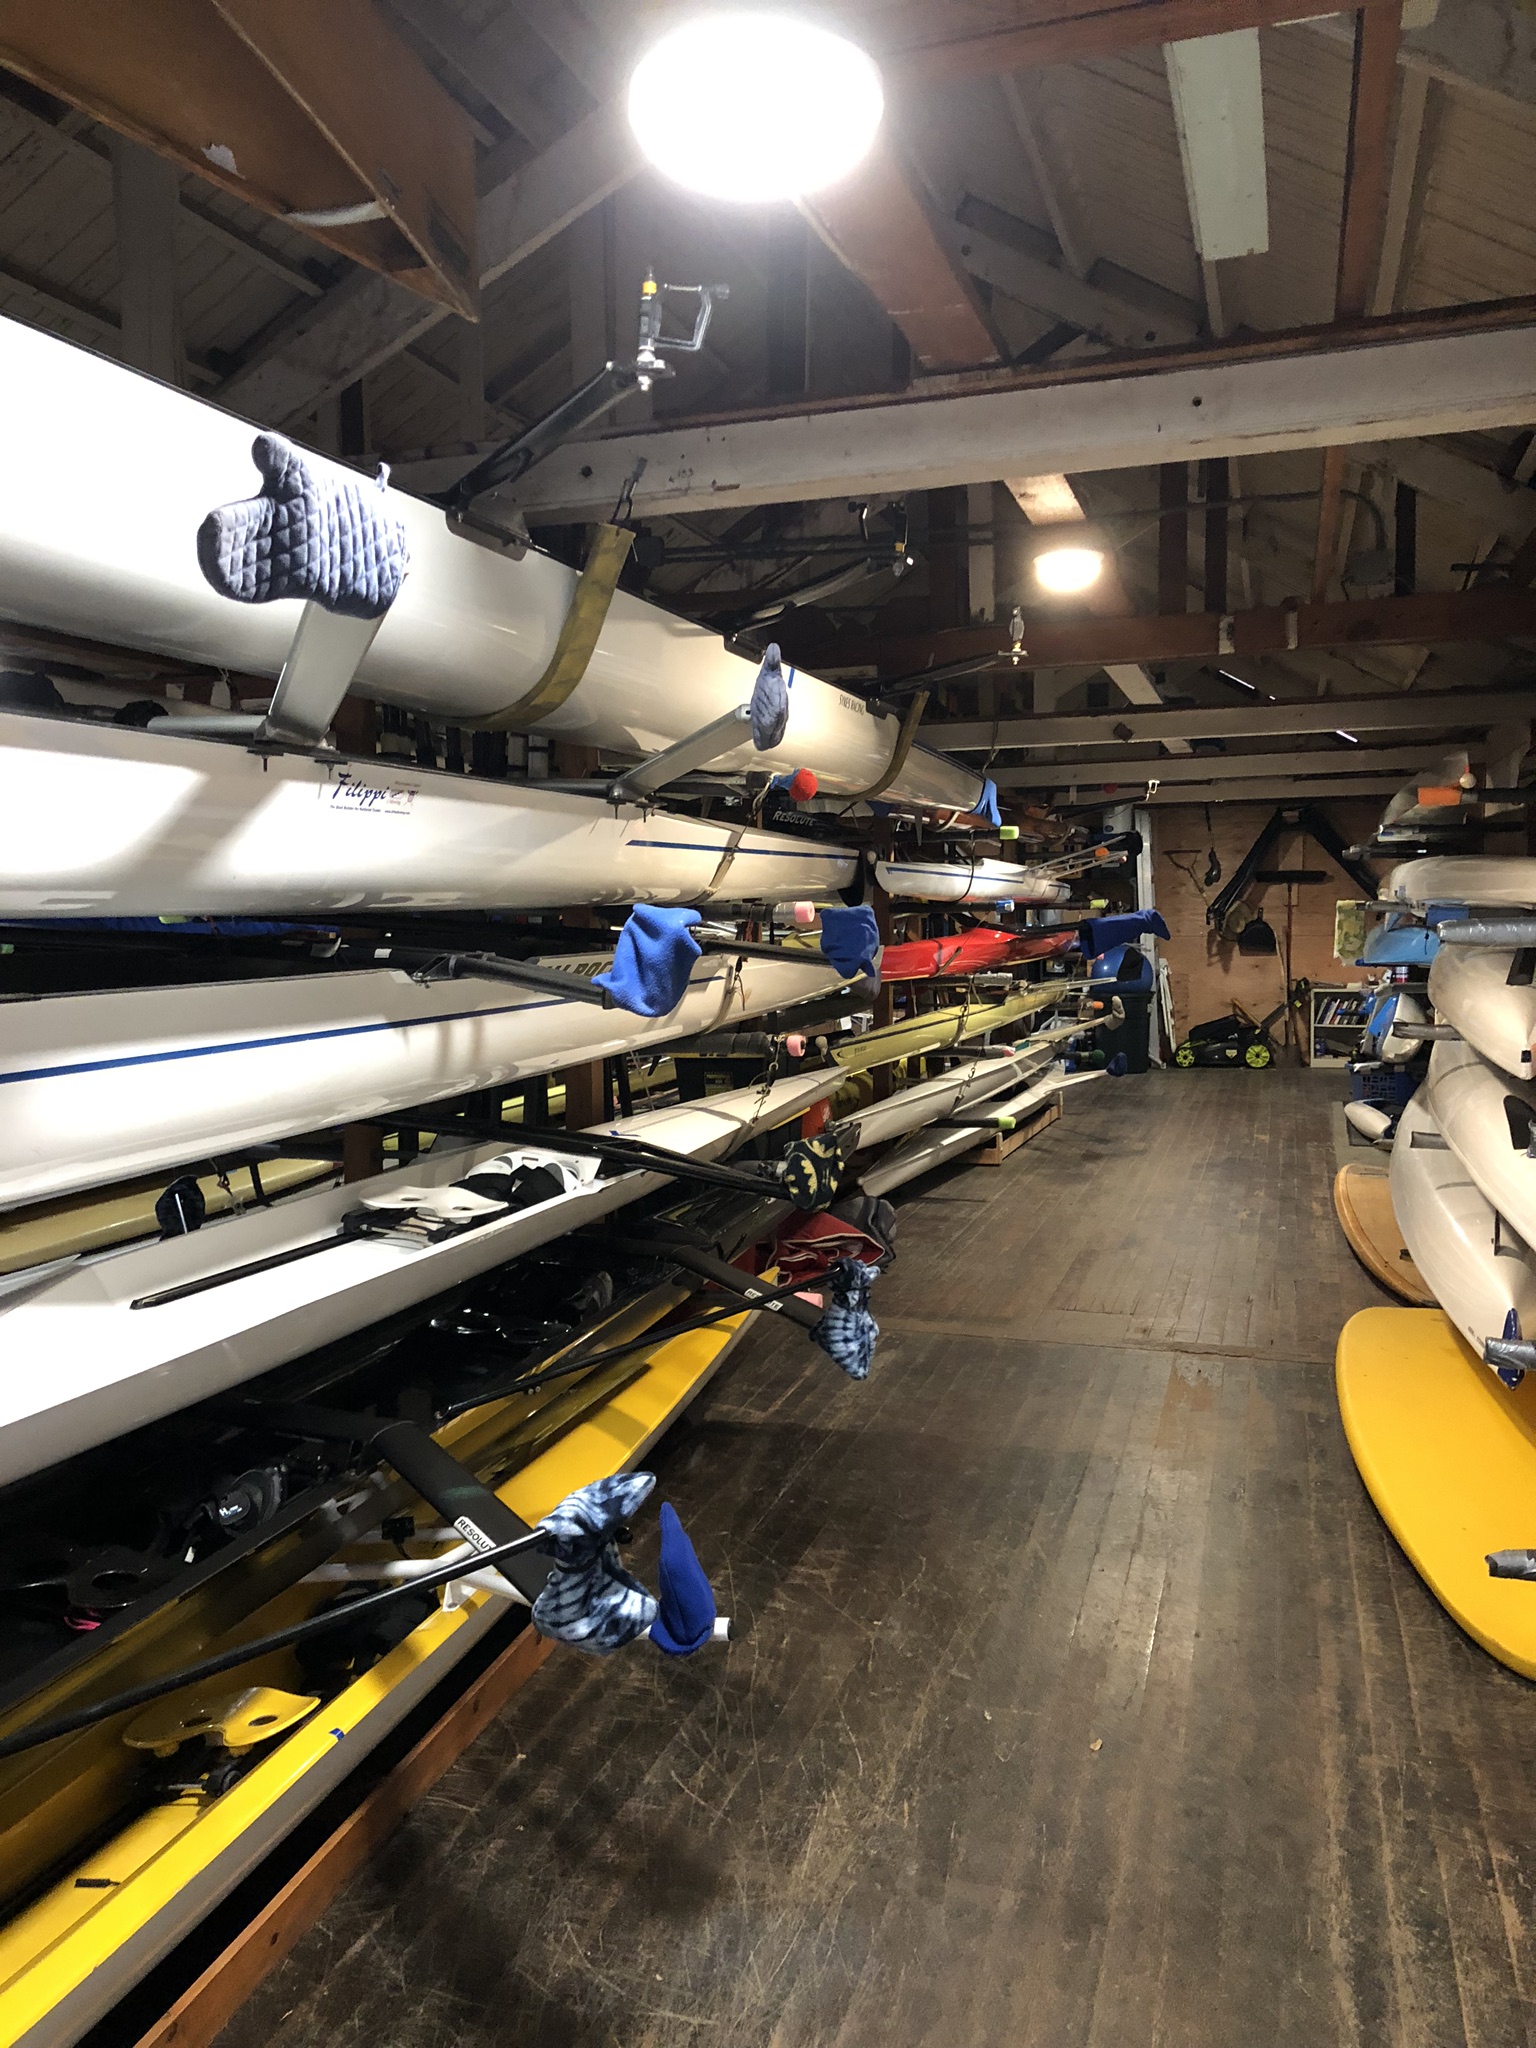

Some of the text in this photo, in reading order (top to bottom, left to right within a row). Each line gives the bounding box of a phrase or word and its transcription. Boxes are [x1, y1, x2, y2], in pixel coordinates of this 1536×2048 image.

[332, 772, 390, 807] Filippi
[772, 810, 816, 827] RESOLUTE
[457, 1518, 492, 1551] RESOLUT
